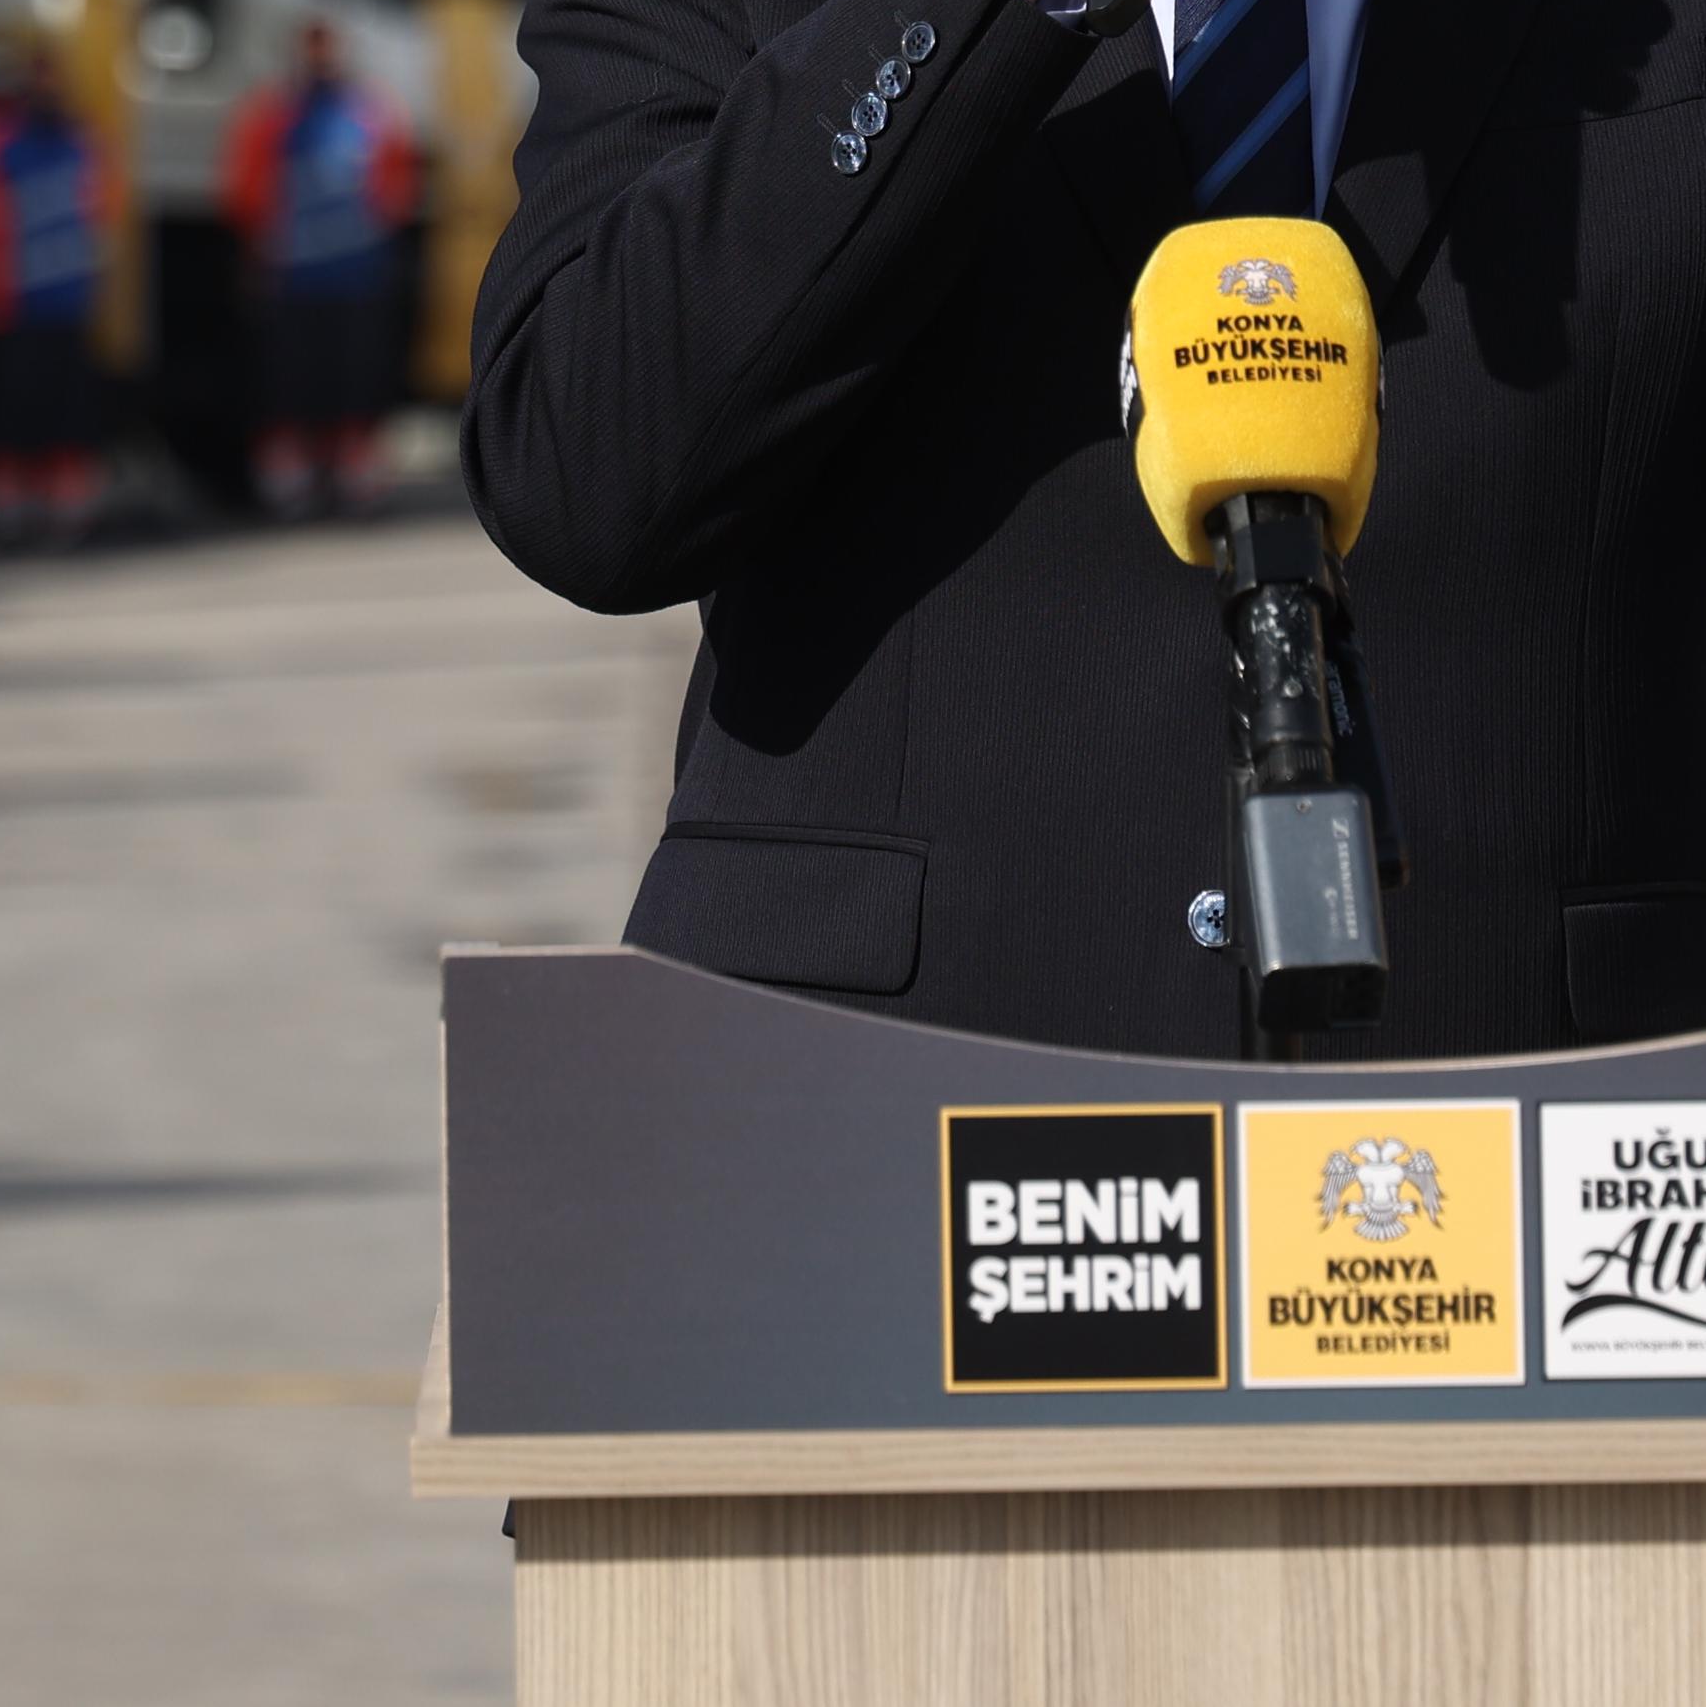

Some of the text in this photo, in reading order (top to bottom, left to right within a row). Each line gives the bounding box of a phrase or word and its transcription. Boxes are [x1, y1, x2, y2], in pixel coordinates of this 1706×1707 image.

[1217, 315, 1304, 334] KONYA
[1174, 335, 1349, 369] BÜYÜKŞEHİR
[1207, 362, 1322, 385] BELEDİYESİ
[1325, 1256, 1439, 1283] KONYA
[1268, 1284, 1497, 1329] BÜYÜKŞEHİR
[1315, 1330, 1451, 1355] BELEDİYESİ
